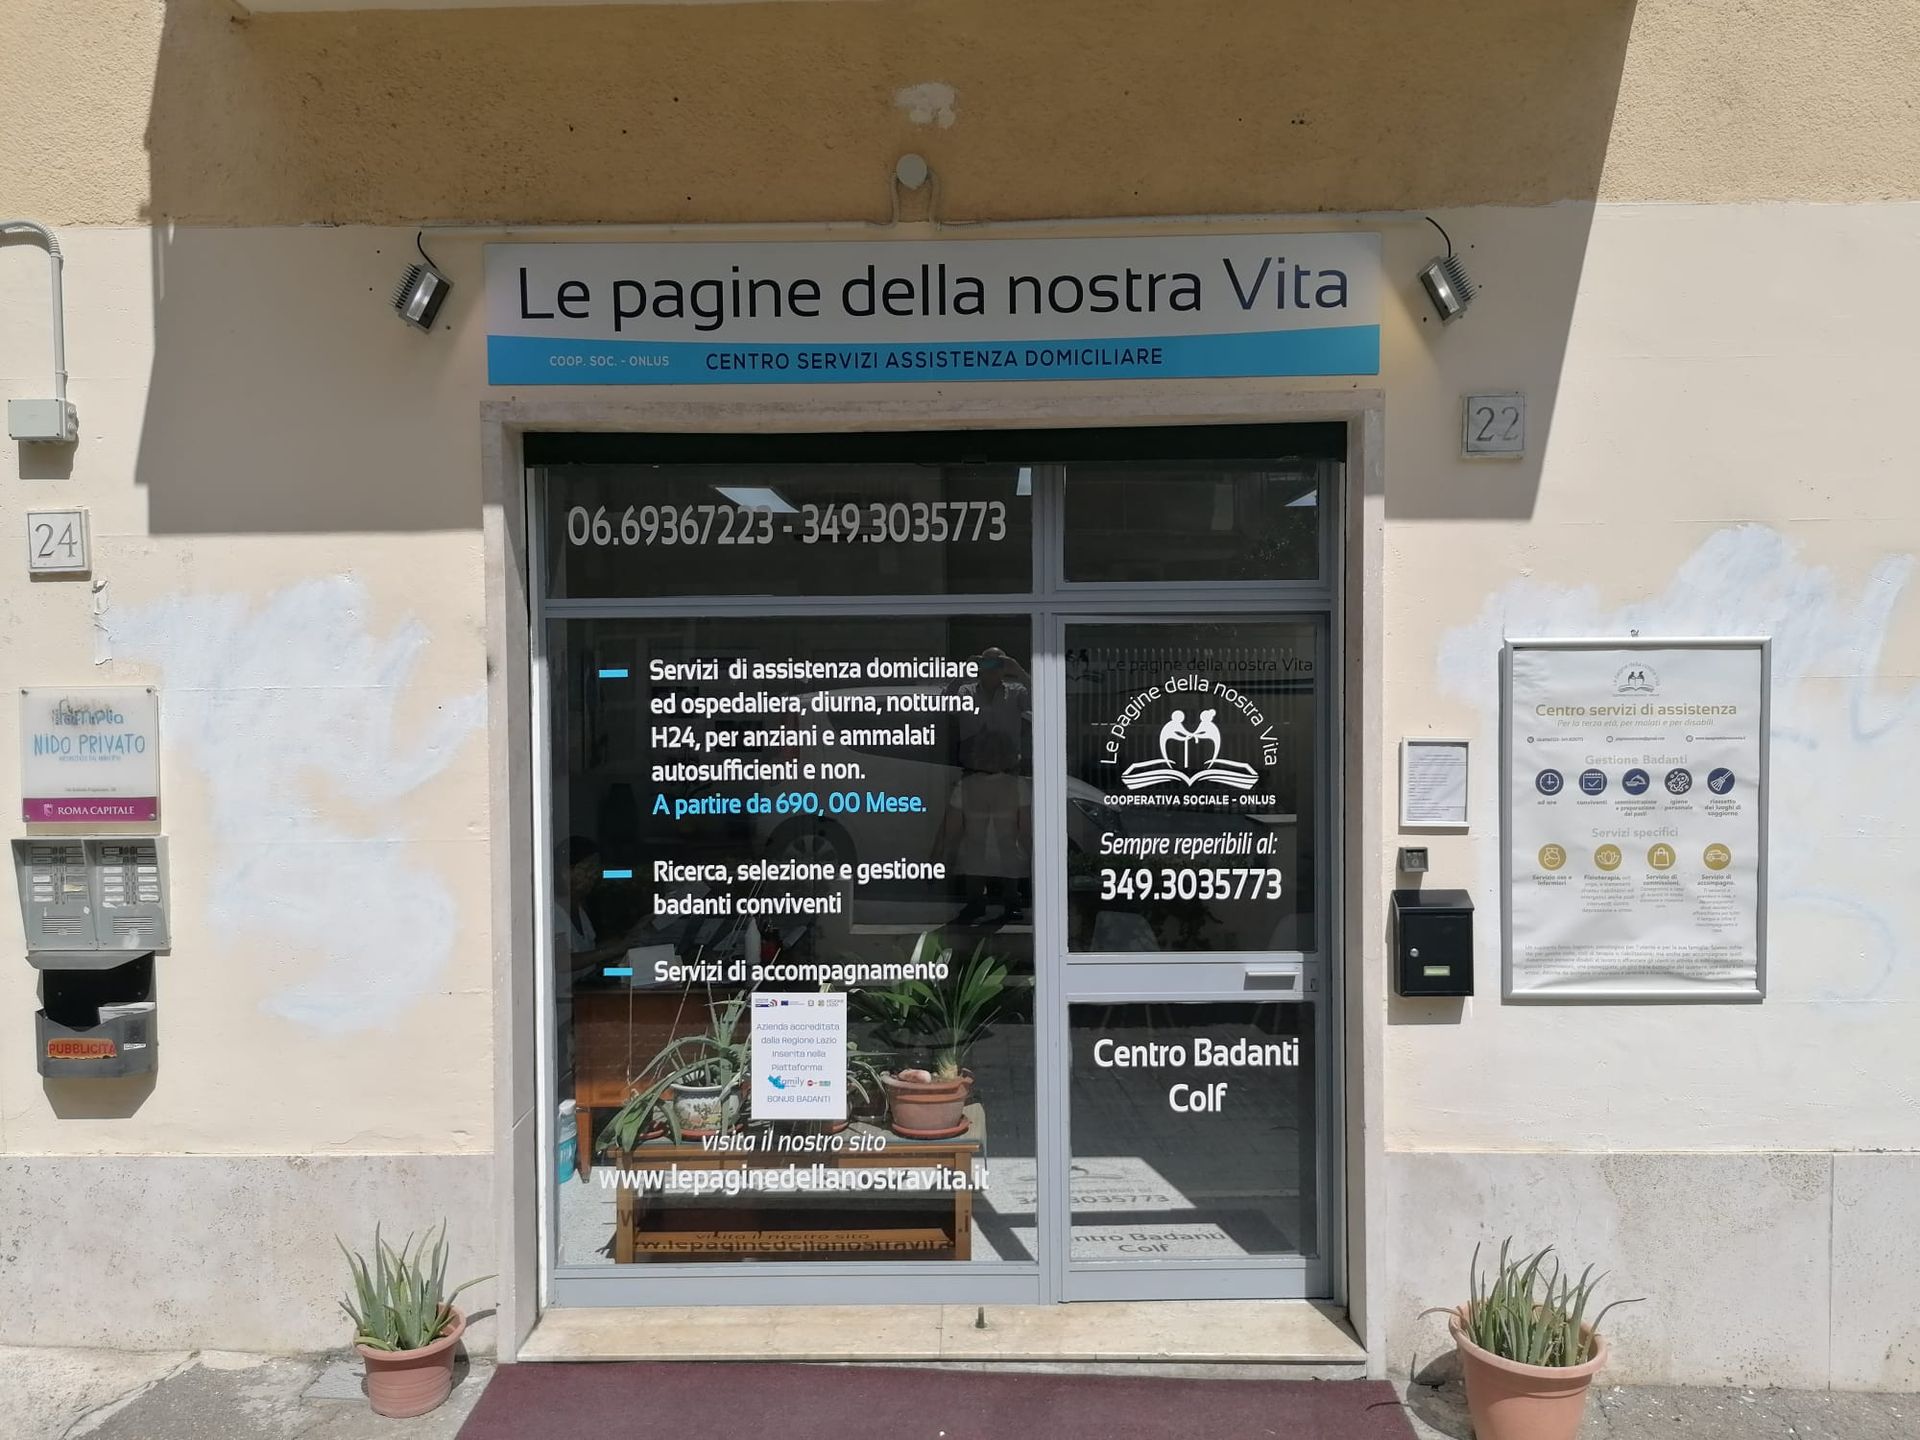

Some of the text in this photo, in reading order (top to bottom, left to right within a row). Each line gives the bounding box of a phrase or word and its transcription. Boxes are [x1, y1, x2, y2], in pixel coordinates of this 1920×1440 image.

[519, 257, 1348, 332] Le pagine della nostra Vita
[549, 355, 588, 367] COOP.
[589, 355, 618, 367] SOC.
[629, 355, 670, 367] ONLUS
[706, 347, 1163, 370] CENTRO SERVIZI ASSISTENZA DOMICILIARE
[1476, 406, 1519, 442] 22
[567, 503, 774, 546] 06.69367223
[802, 501, 1007, 544] 349.3035773
[35, 521, 78, 559] 24
[649, 656, 979, 681] Servizi di assistenza domiciliare
[1282, 657, 1313, 671] Vita
[650, 690, 980, 719] ed ospedaliera, diurna, notturna,
[1535, 703, 1737, 717] Centro servizi di assistenza
[1100, 674, 1280, 766] Le pagine della nostra Vita
[1557, 720, 1570, 728] Per
[33, 733, 146, 757] NIDO PRIVATO
[651, 723, 936, 752] H24, per anziani e ammalati
[651, 758, 866, 782] autosufficienti e non.
[1585, 754, 1687, 765] Gestione Badanti
[58, 806, 135, 815] ROMA CAPITALE
[652, 791, 927, 820] A partire da 690, 00 Mese.
[1103, 795, 1181, 806] COOPERATIVA
[1183, 794, 1230, 805] SOCIALE
[1239, 794, 1276, 805] ONLUS
[1100, 831, 1278, 860] Sempre reperibili al:
[1592, 827, 1678, 839] Servizi specifici
[653, 857, 946, 885] Ricerca, selezione e gestione
[1100, 868, 1282, 900] 349.3035773
[653, 891, 842, 916] badanti conviventi
[654, 959, 949, 986] Servizi di accompagnamento
[757, 1022, 840, 1030] Azienda accreditata
[782, 1036, 814, 1046] Regione
[816, 1036, 837, 1044] Lazio
[1093, 1037, 1300, 1067] Centro Badanti
[1169, 1082, 1228, 1112] Colf
[702, 1130, 887, 1153] visita il nostro sito
[599, 1162, 990, 1196] www.lepaginedellanostravita.it
